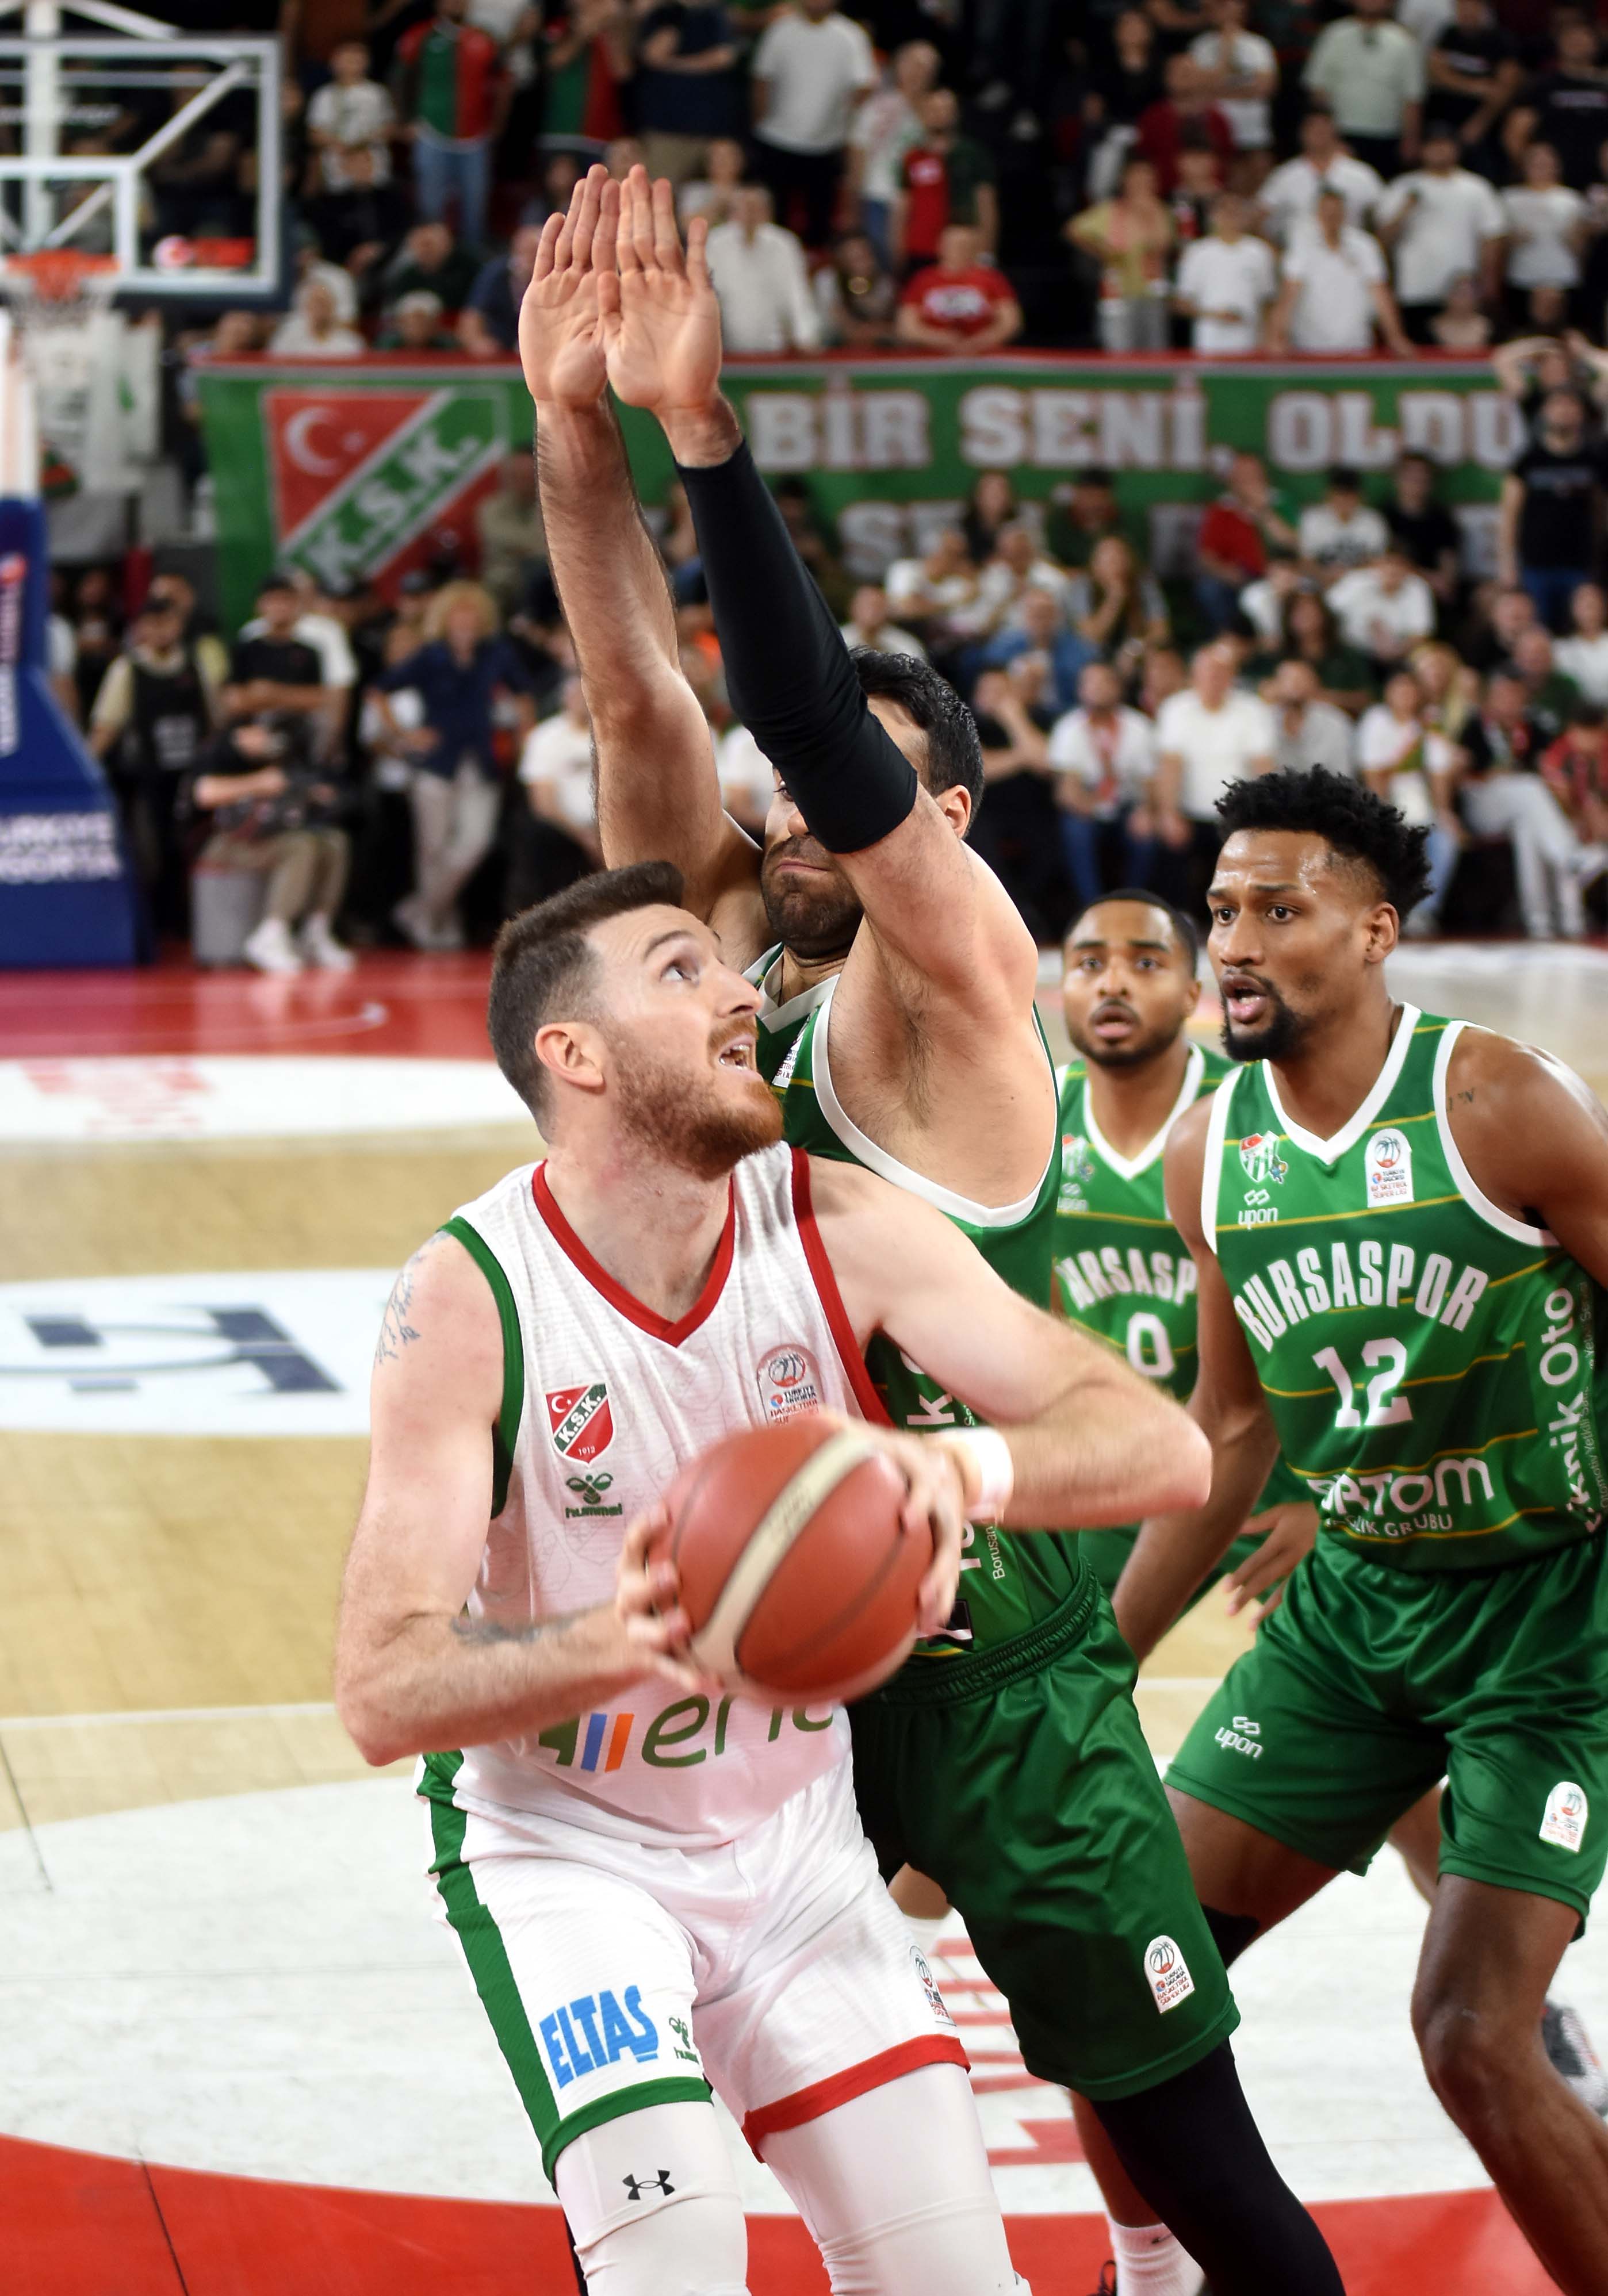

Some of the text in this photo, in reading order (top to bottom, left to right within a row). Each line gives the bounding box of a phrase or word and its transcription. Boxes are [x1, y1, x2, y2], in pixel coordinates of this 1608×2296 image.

[749, 371, 932, 472] BİR
[1238, 1207, 1278, 1230] upon
[1234, 1240, 1489, 1353] BURSASPOR
[1127, 1312, 1174, 1377] 0
[1540, 1287, 1579, 1385] Oto
[1312, 1337, 1413, 1428] 12
[558, 1396, 602, 1444] K.S.K.
[579, 1445, 596, 1456] 1912
[565, 1502, 623, 1519] hummel
[1384, 1514, 1452, 1536] GRUBU
[986, 1525, 1005, 1580] Borusan
[1215, 1727, 1264, 1758] upon
